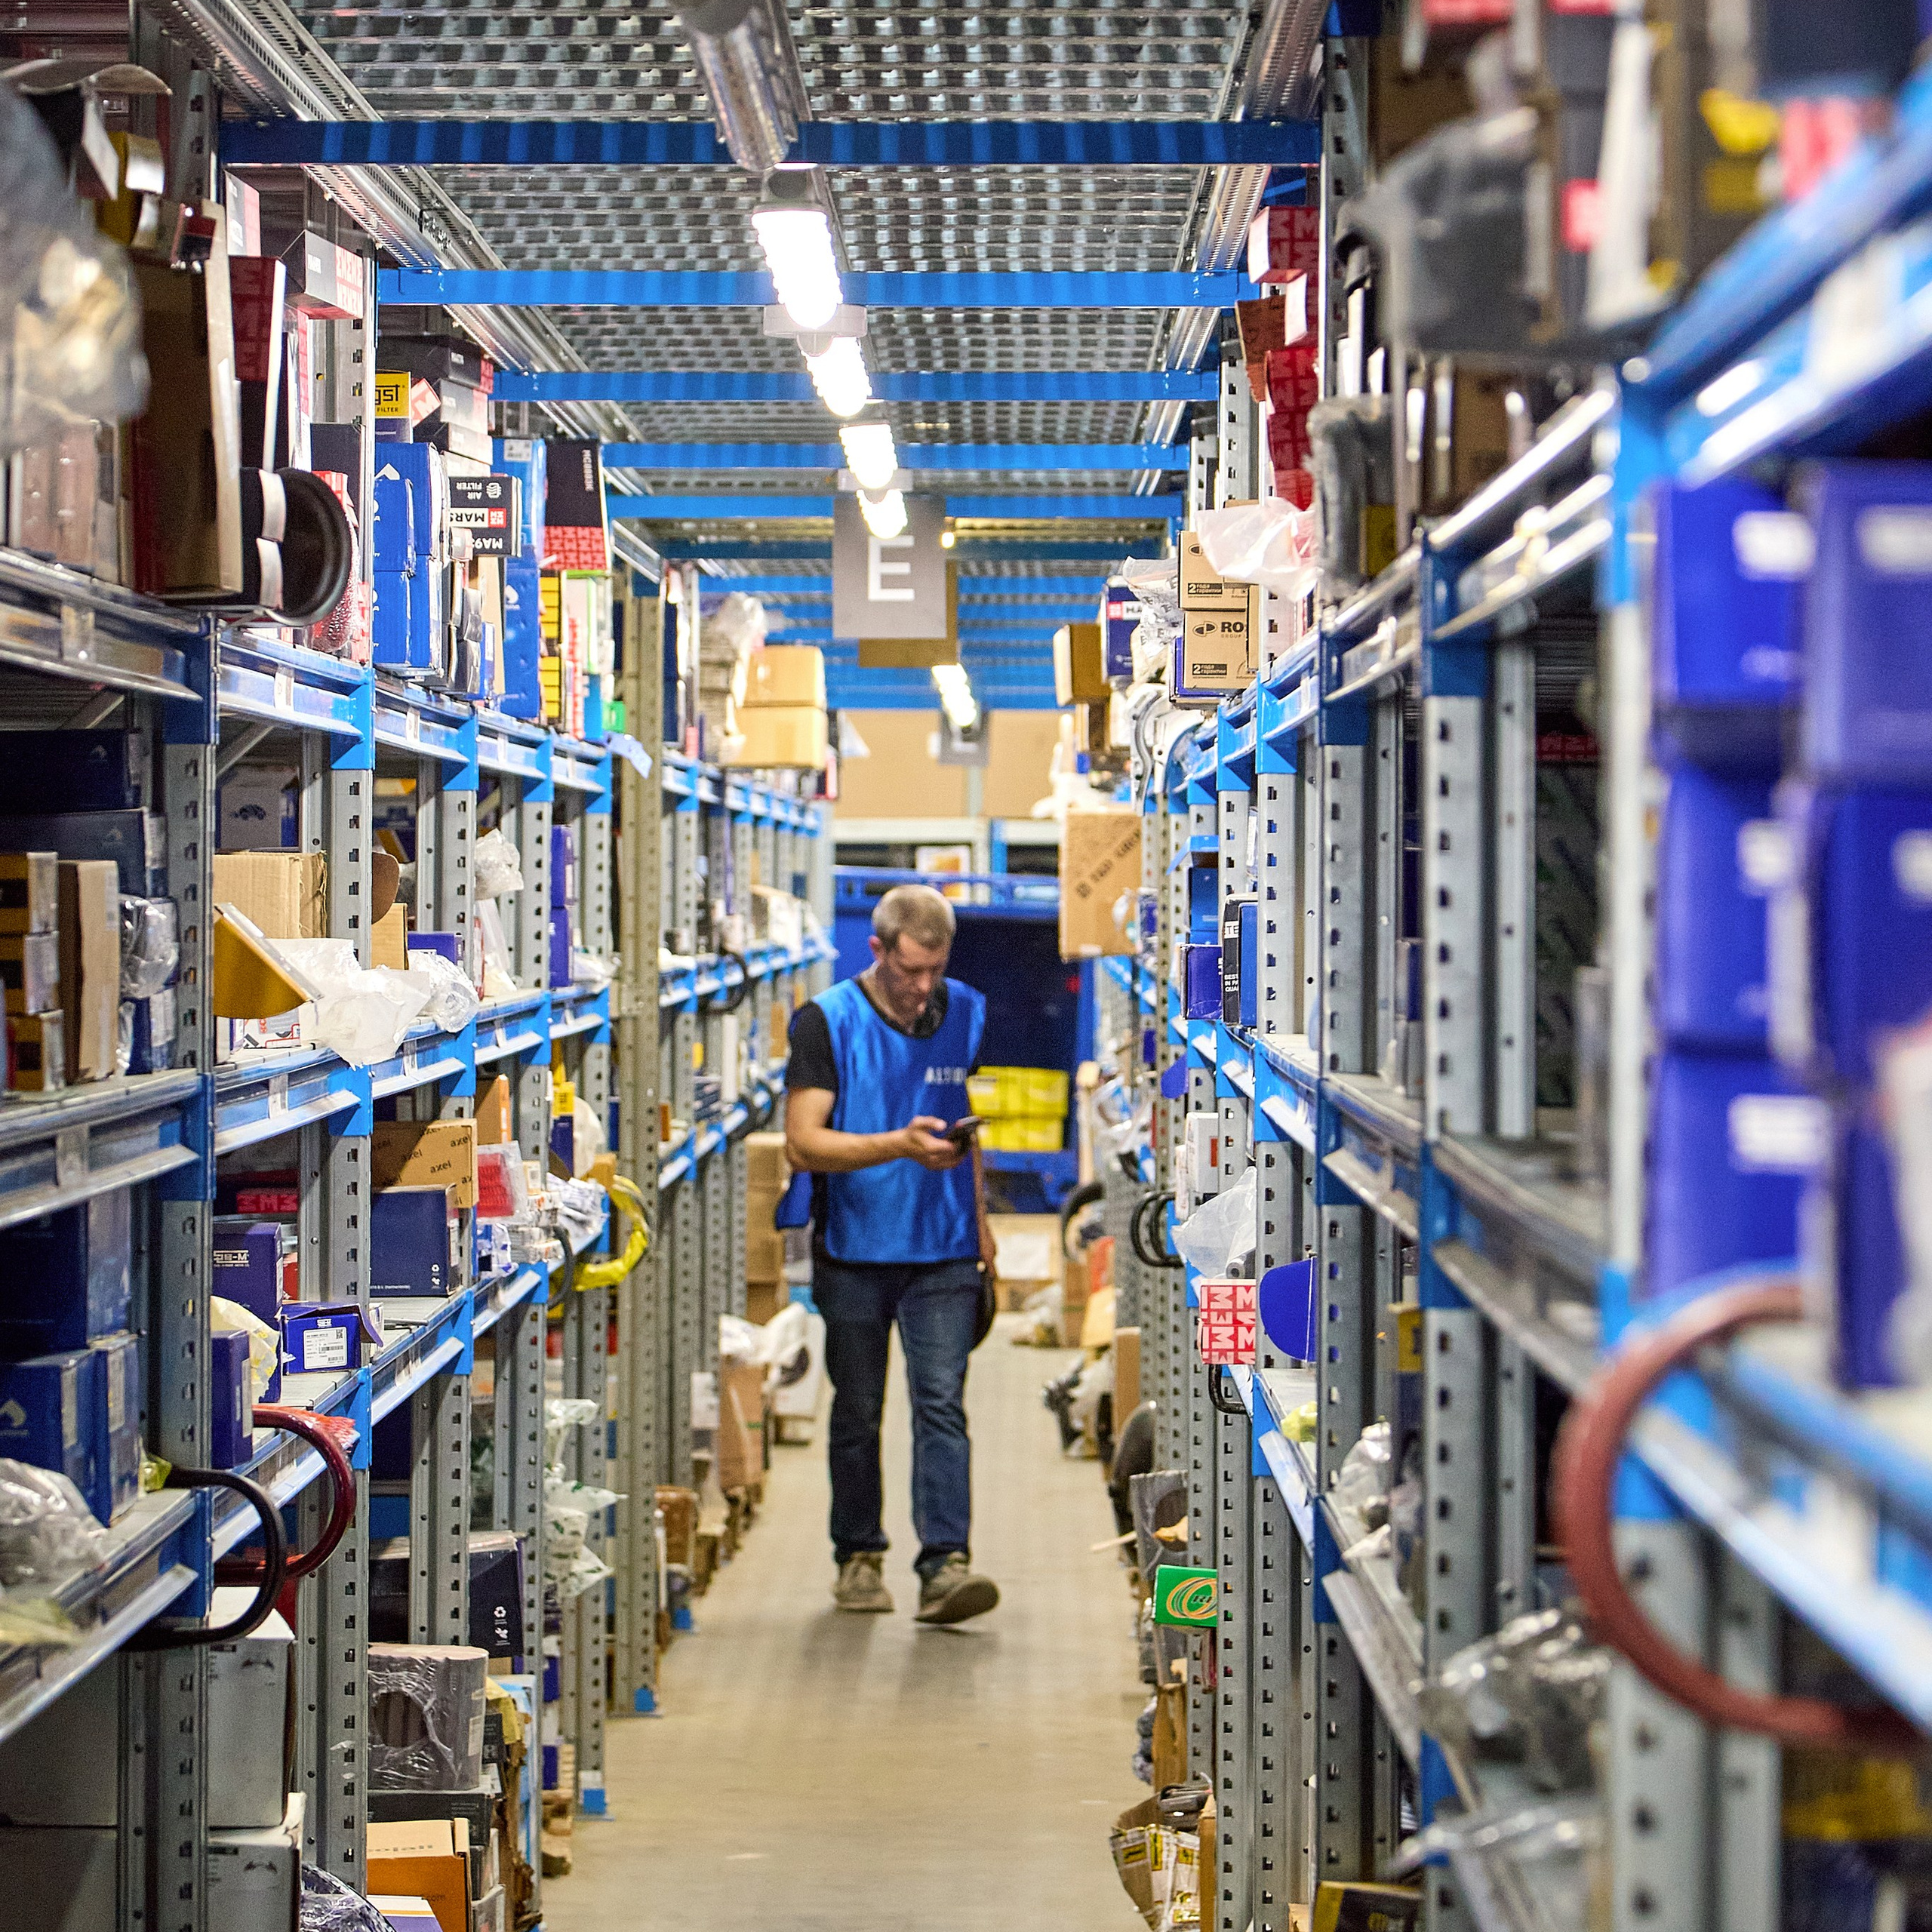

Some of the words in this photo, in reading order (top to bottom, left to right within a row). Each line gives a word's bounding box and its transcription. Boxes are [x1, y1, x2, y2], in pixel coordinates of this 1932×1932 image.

[456, 482, 482, 491] FILTER
[467, 491, 482, 500] AIR
[868, 534, 915, 601] E
[1188, 583, 1197, 594] 2
[1221, 621, 1246, 633] RO
[1193, 664, 1201, 675] 2
[430, 1159, 452, 1174] axel
